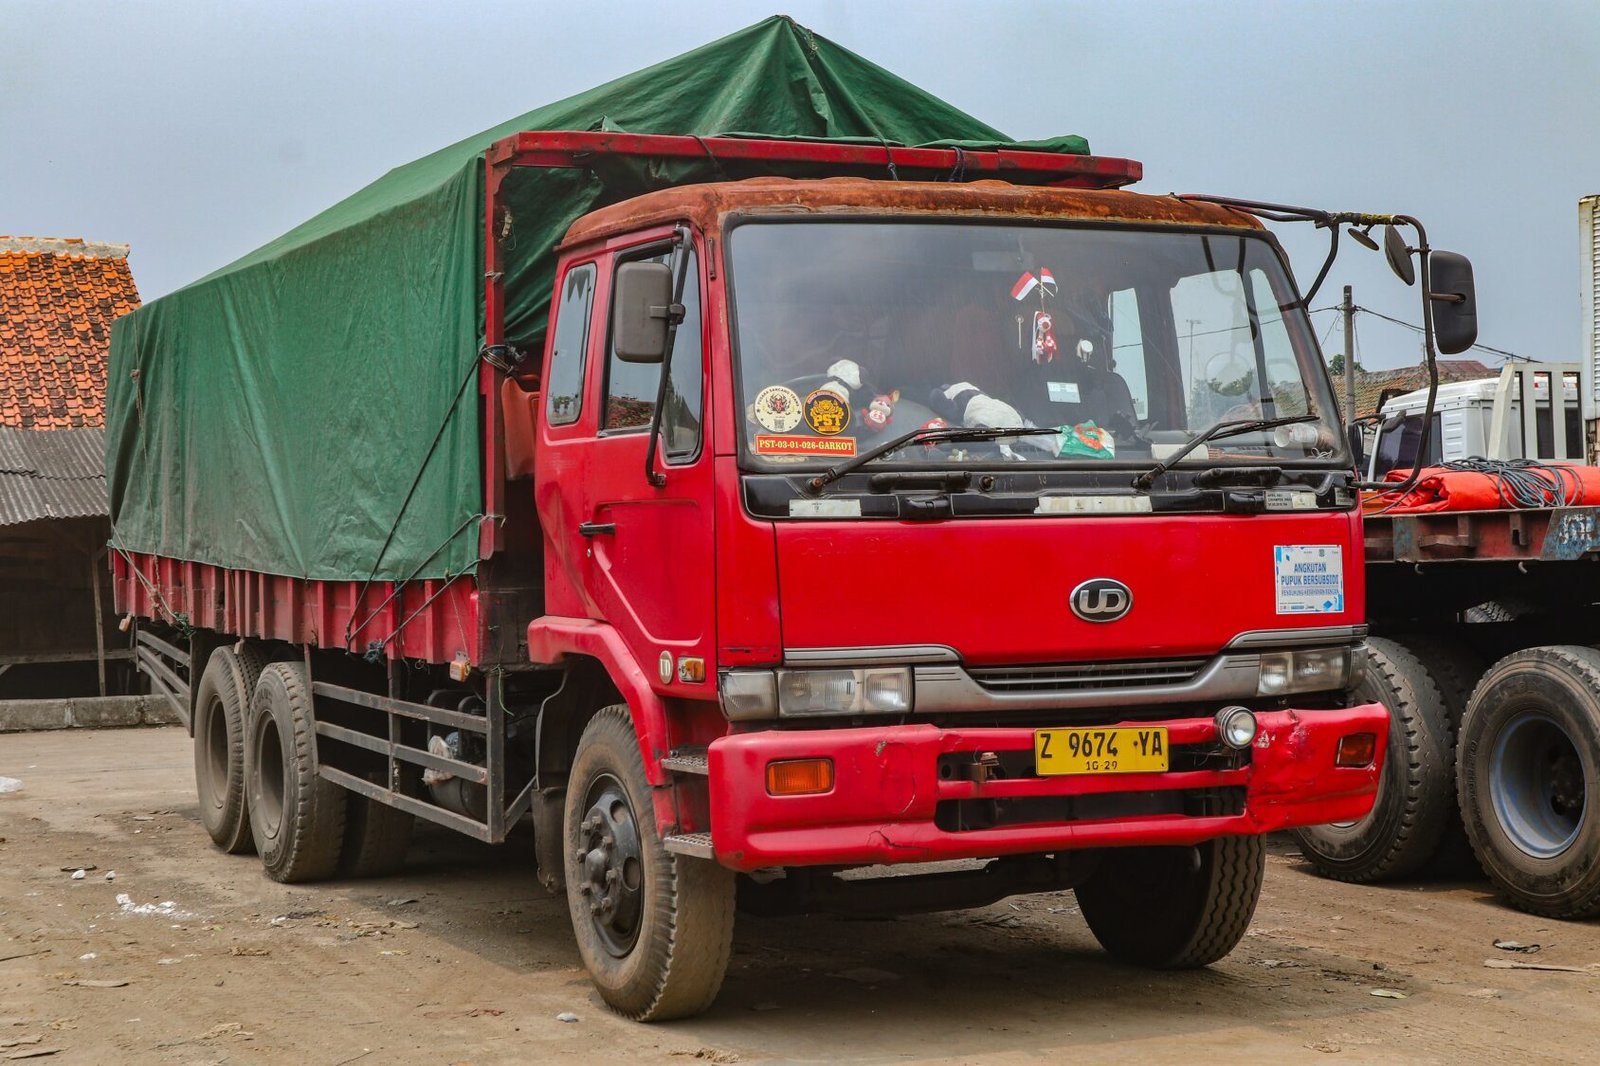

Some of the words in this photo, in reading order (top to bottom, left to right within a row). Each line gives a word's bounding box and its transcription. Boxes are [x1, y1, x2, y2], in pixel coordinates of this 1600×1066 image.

[813, 413, 842, 427] PST
[1294, 562, 1327, 573] ANGKUTAN
[1281, 575, 1302, 586] PUPUK
[1303, 574, 1339, 585] BERSUBSIDI
[1079, 588, 1127, 614] UD
[1040, 733, 1053, 759] Z
[1068, 732, 1118, 758] 9674
[1138, 731, 1163, 756] YA
